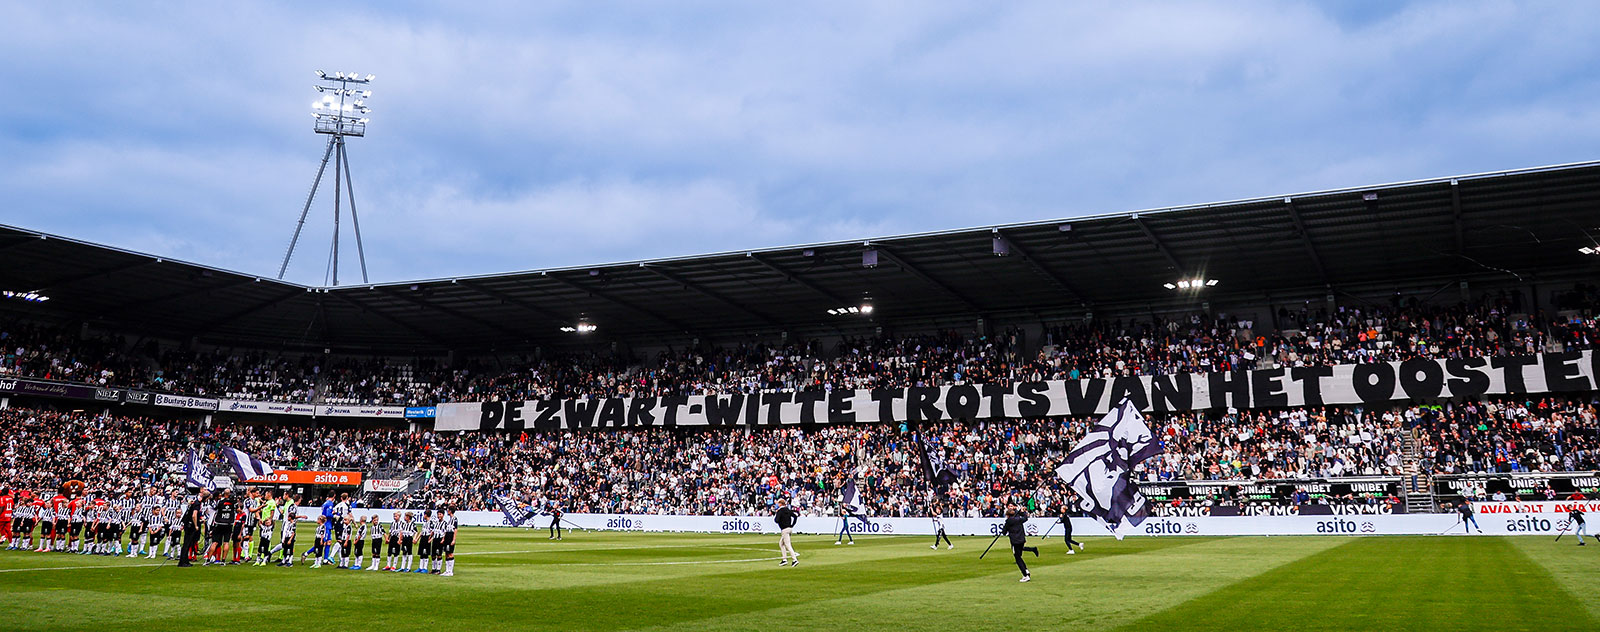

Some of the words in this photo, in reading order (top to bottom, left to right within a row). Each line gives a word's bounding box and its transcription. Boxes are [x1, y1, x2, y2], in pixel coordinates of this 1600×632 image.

[480, 401, 526, 429] DE
[533, 389, 856, 429] ZWART-WITTE
[871, 379, 1051, 422] TROTS
[1064, 373, 1194, 416] VAN
[1208, 365, 1333, 409] HET
[1352, 348, 1600, 403] OOSTE
[314, 472, 339, 483] asito
[1350, 482, 1388, 492] UNIBET
[1329, 503, 1393, 515] VISYMO
[606, 515, 632, 528] asito
[722, 518, 750, 531] asito
[1145, 518, 1181, 534] asito
[1317, 516, 1356, 533] asito
[1507, 514, 1551, 532] asito
